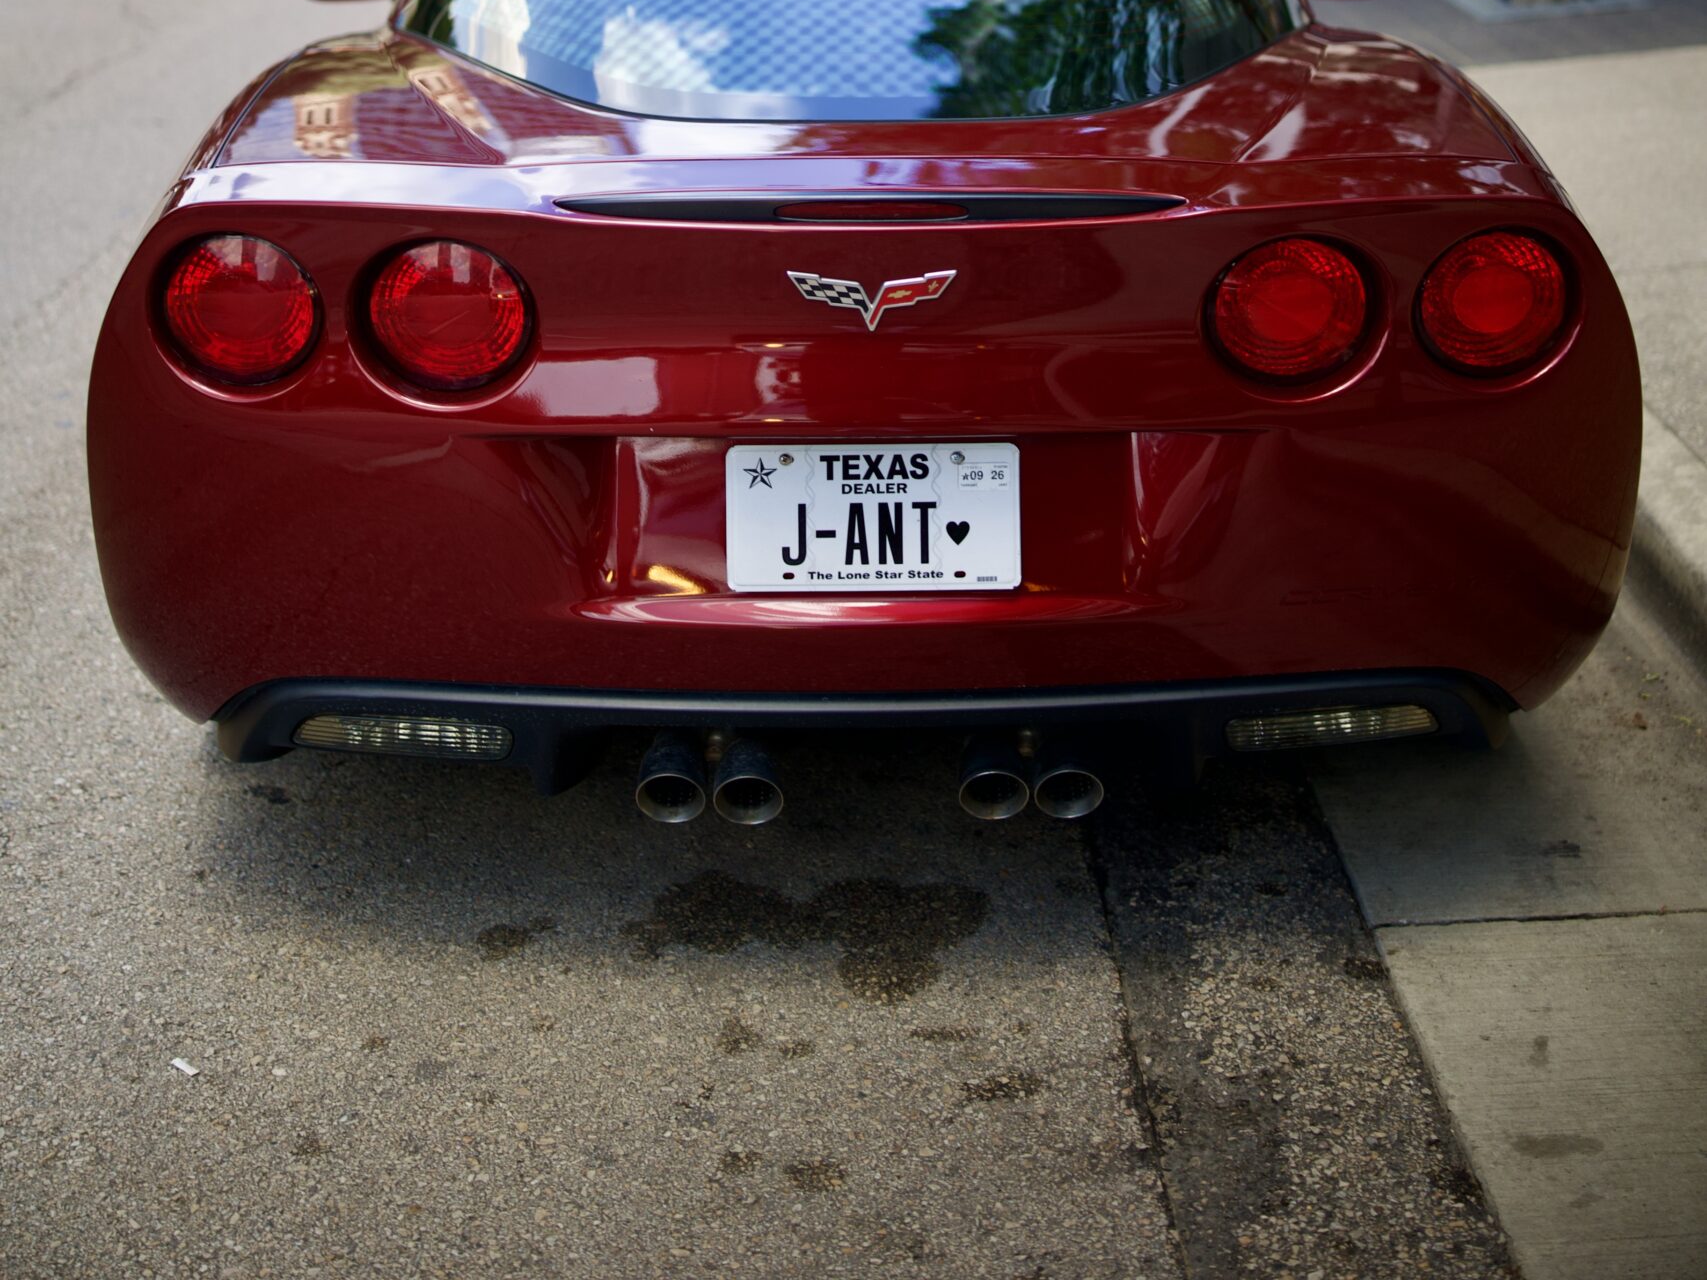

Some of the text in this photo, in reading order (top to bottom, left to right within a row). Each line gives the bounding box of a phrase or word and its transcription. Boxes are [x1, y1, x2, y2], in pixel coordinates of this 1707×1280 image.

[819, 453, 930, 481] TEXAS
[969, 470, 1005, 480] 09 26
[841, 483, 908, 495] DEALER
[781, 501, 937, 566] J-ANT
[808, 570, 944, 580] The Lone Star State
